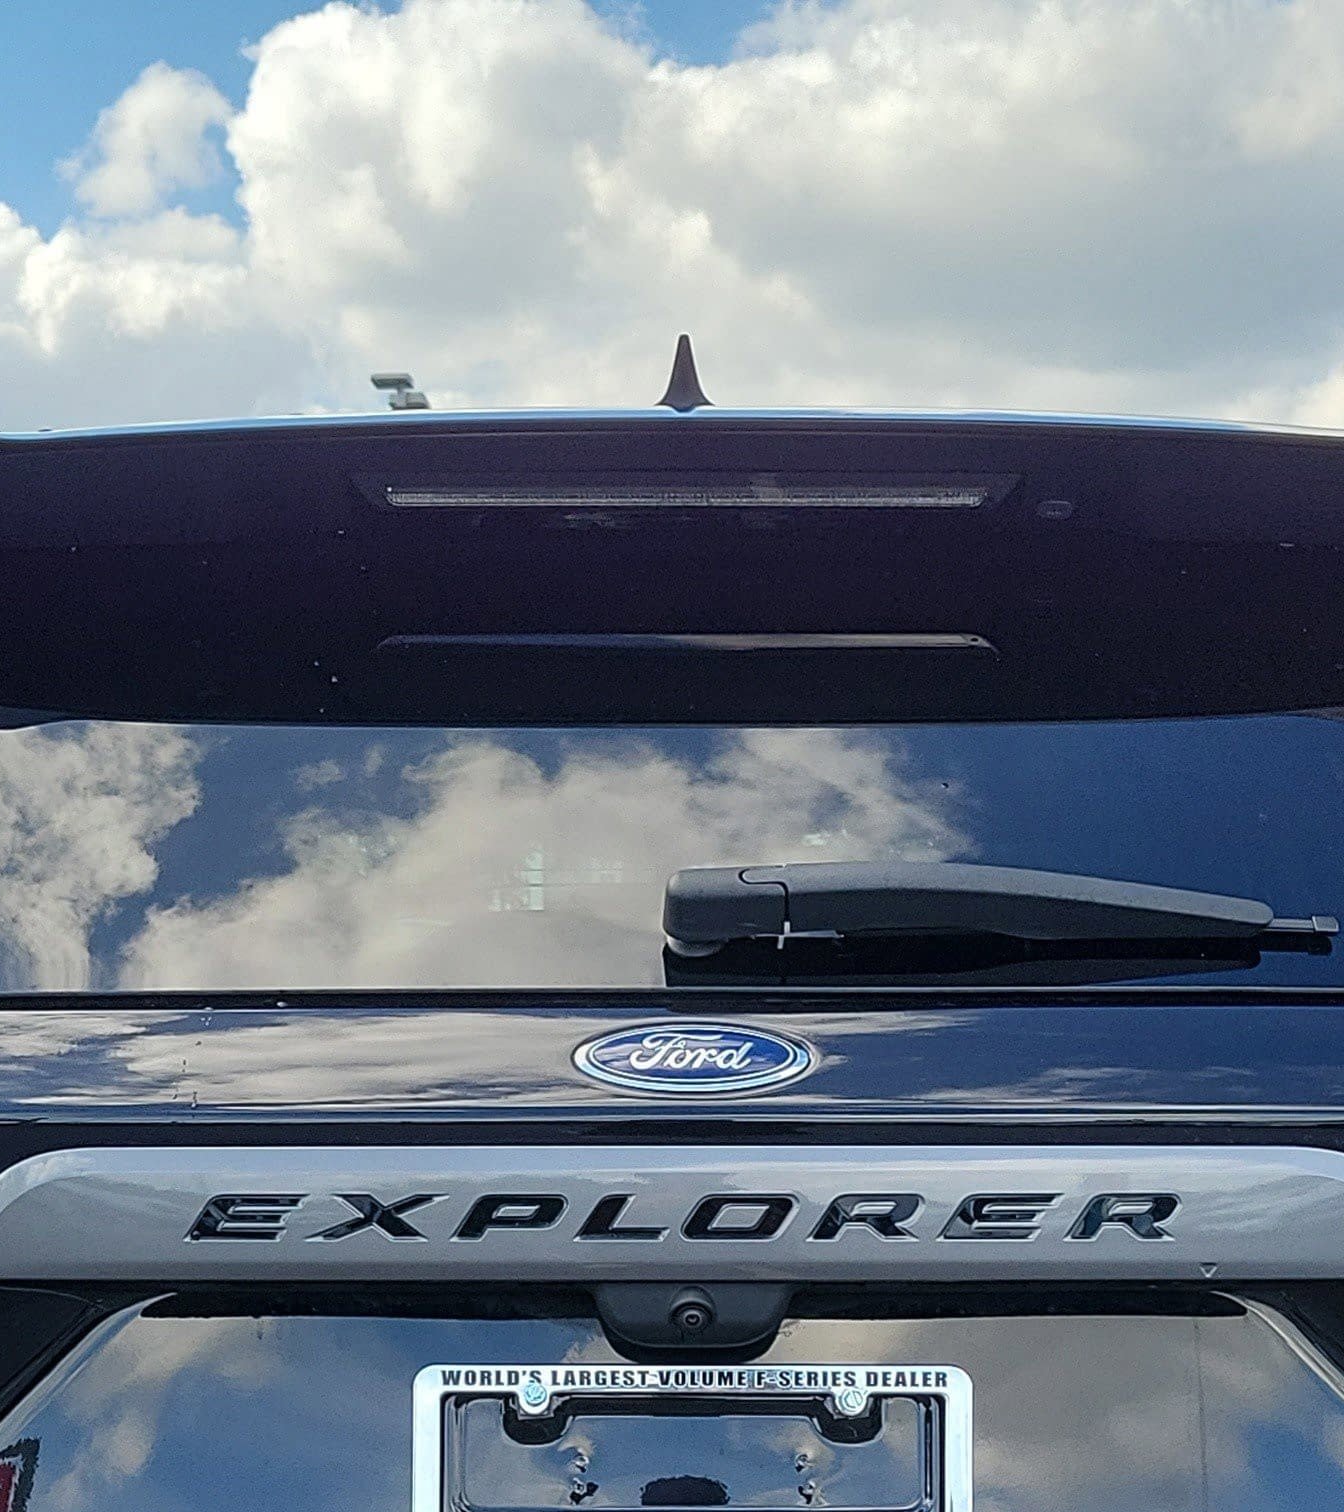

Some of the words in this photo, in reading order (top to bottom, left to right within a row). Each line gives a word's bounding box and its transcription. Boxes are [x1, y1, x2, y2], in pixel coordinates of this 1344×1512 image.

[629, 1032, 753, 1070] Ford
[181, 1193, 1181, 1244] EXPLORER
[441, 1370, 542, 1386] WORLD'S
[551, 1370, 649, 1386] LARGEST
[657, 1371, 747, 1386] VOLUME
[757, 1371, 856, 1387] F-SERIES
[866, 1371, 948, 1387] DEALER
